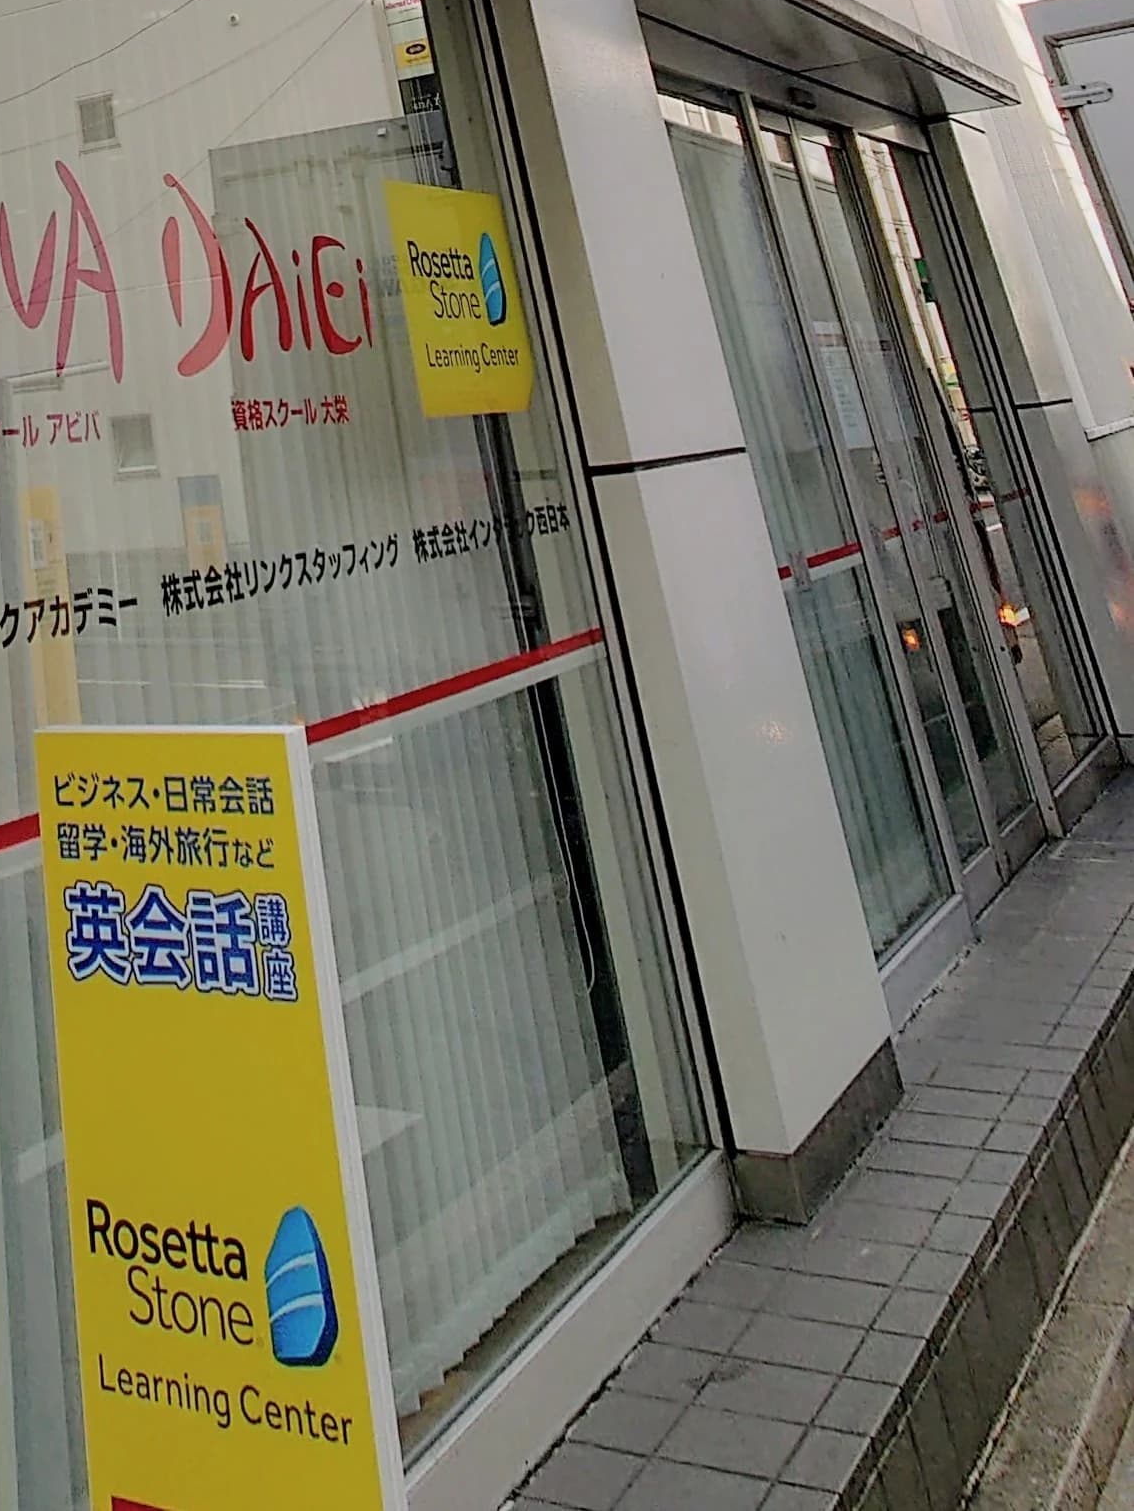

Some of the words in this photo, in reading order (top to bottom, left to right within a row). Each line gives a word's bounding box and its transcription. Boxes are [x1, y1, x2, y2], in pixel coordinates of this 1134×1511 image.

[407, 240, 475, 280] Rosetta
[430, 280, 482, 320] Stone
[426, 343, 480, 374] Learning
[481, 343, 519, 367] Center
[46, 408, 102, 444] アビバ
[232, 397, 318, 431] 資格スクール
[322, 394, 349, 424] 大栄
[161, 533, 399, 618] 株式会社リンクスタッフィング
[54, 772, 274, 816] ビジネス・日常会話
[57, 822, 274, 869] 留学・海外旅行など
[65, 880, 261, 996] 英会話
[254, 893, 298, 1002] 講座
[86, 1198, 248, 1281] Rosetta
[126, 1264, 255, 1347] Stone
[98, 1353, 231, 1428] Learning
[239, 1384, 353, 1445] Center
